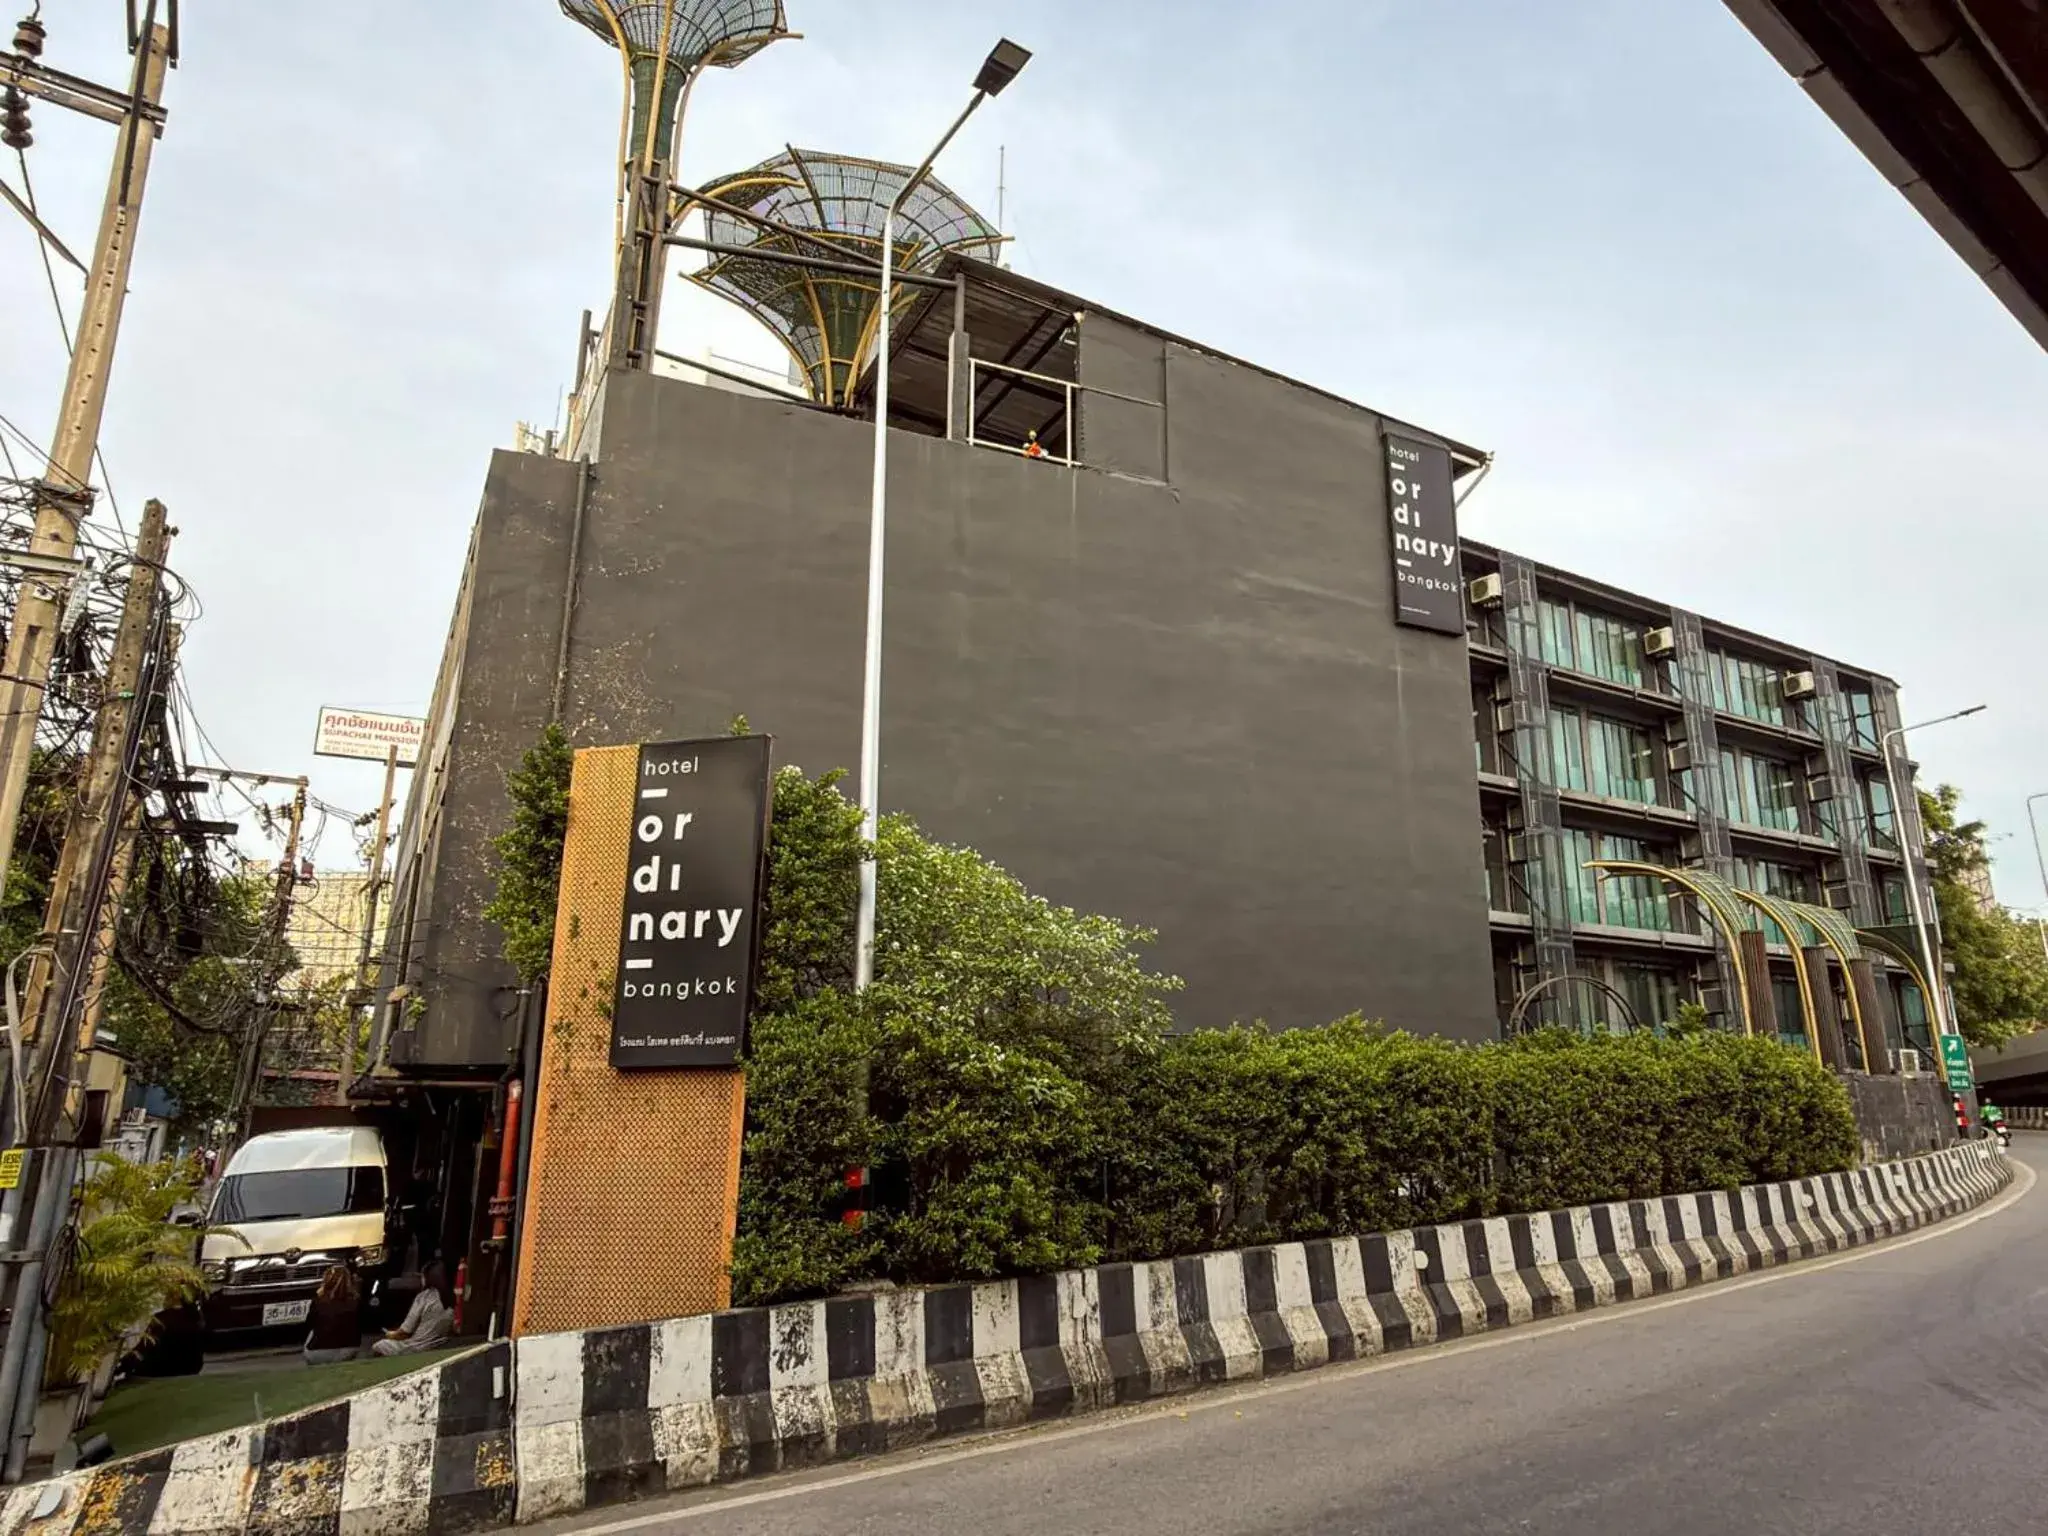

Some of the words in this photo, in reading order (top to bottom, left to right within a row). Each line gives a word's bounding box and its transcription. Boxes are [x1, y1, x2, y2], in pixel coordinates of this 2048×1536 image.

[1389, 445, 1420, 463] hotel
[1391, 477, 1421, 500] or
[1395, 531, 1455, 566] nary
[1397, 571, 1459, 593] bangkok
[323, 728, 372, 740] SUPACHAI
[374, 733, 419, 745] MANSION
[644, 756, 700, 777] hotel
[638, 811, 692, 843] or
[628, 907, 743, 948] nary
[623, 976, 738, 1001] bangkok
